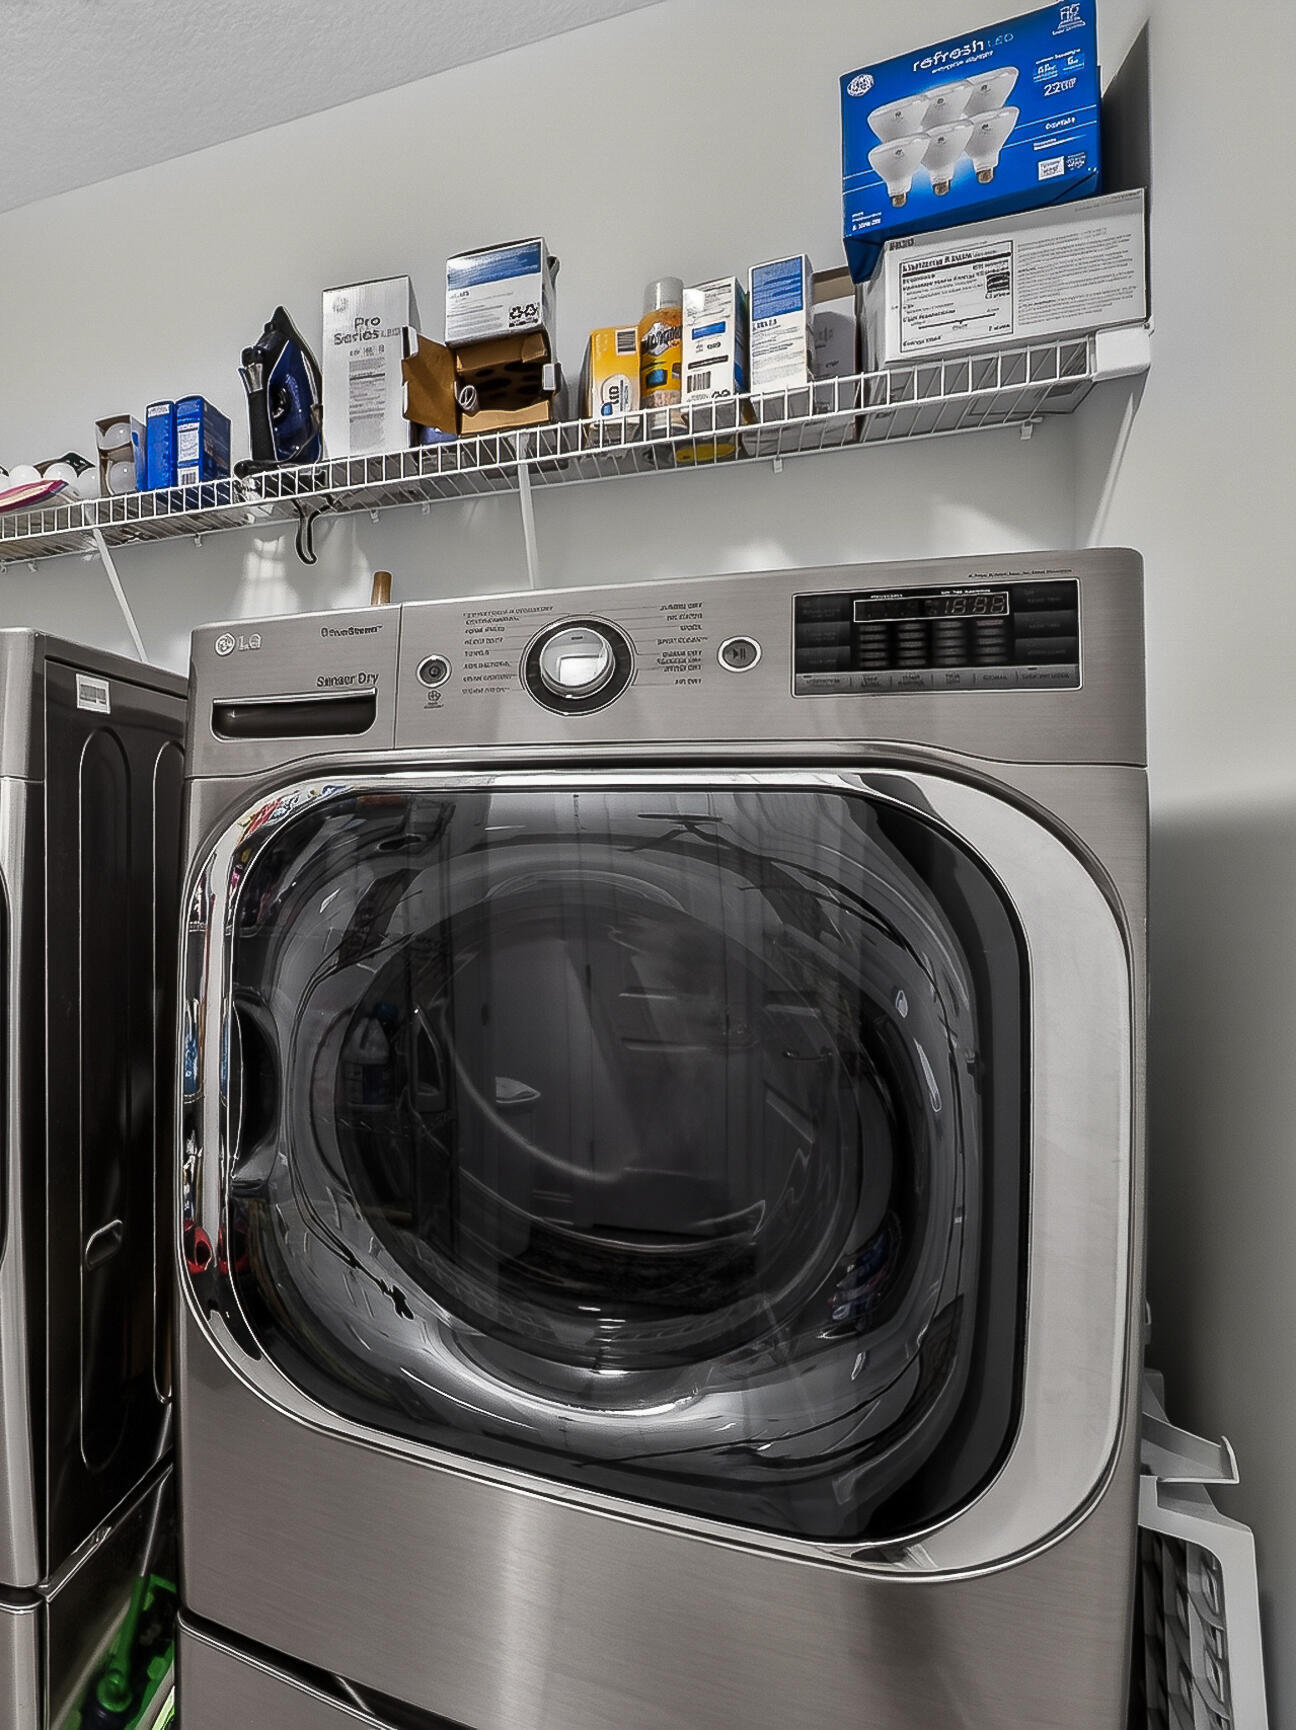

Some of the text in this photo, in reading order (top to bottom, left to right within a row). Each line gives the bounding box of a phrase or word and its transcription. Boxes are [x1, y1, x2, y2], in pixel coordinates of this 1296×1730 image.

[913, 39, 984, 72] refresh
[354, 316, 381, 331] Pro
[333, 327, 380, 346] Series
[238, 633, 262, 651] LG
[316, 672, 380, 687] Sensor Dry
